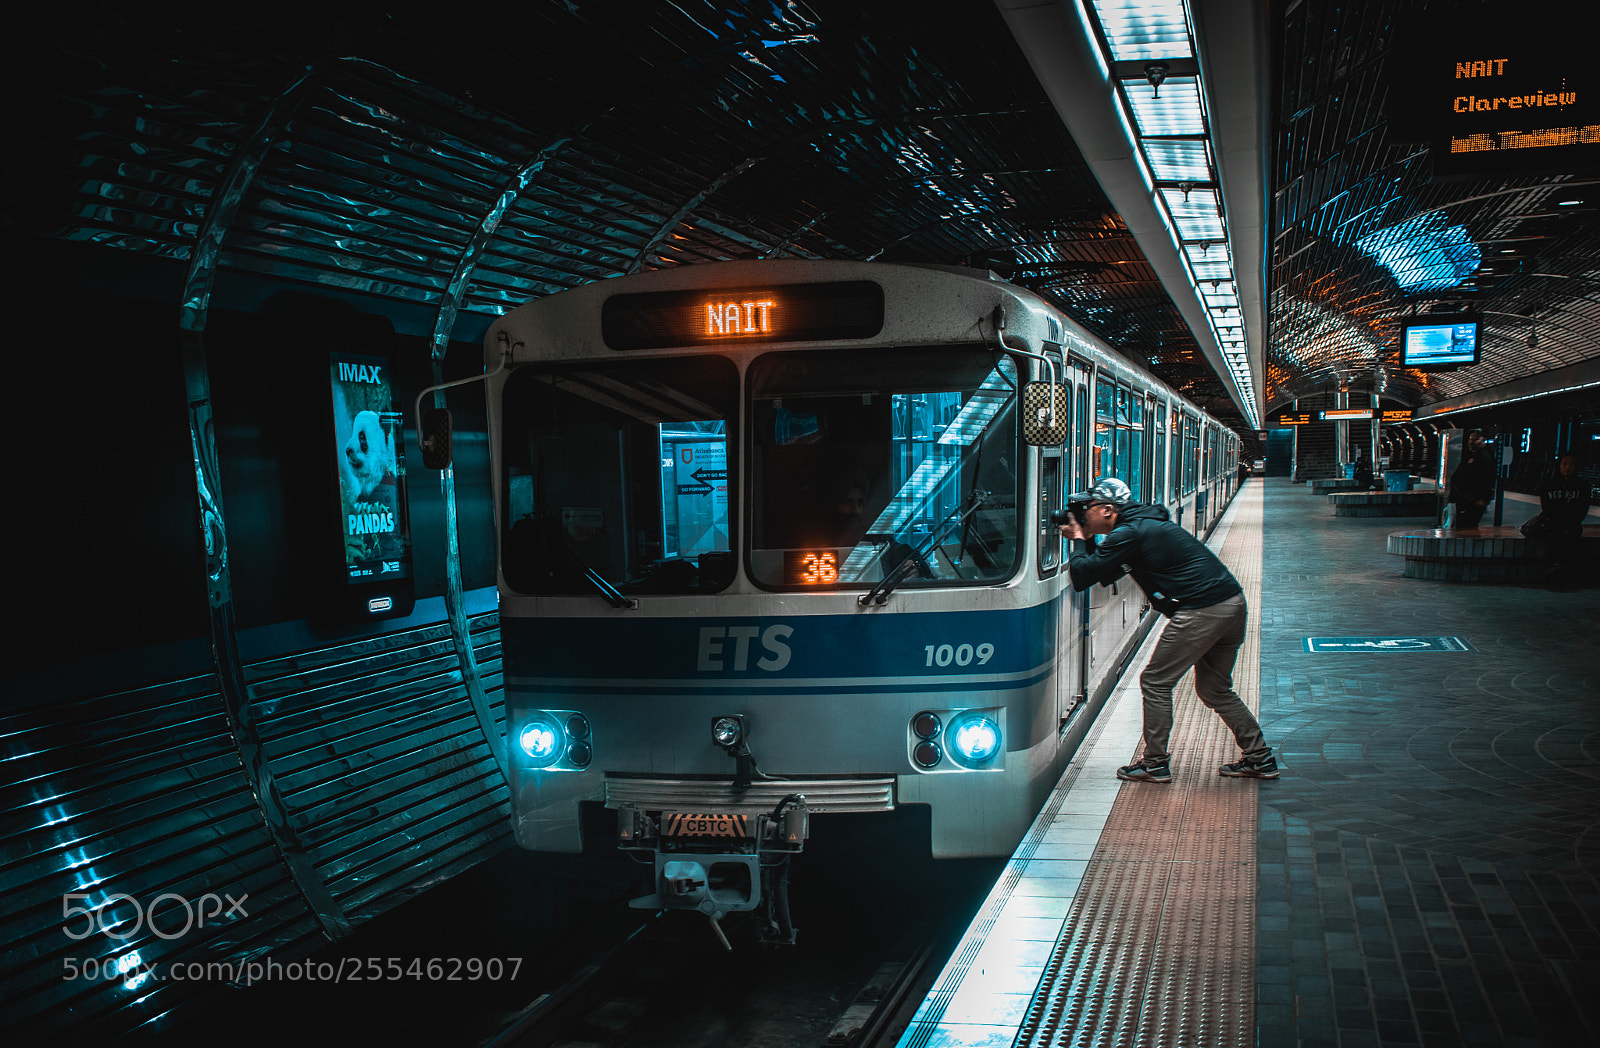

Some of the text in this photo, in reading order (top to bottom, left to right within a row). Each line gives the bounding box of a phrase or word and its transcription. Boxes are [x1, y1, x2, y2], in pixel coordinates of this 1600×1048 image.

[1455, 58, 1508, 79] NAIT
[1453, 89, 1576, 113] Clareview
[705, 300, 776, 335] NAIT
[338, 362, 382, 385] IMAX
[348, 512, 395, 536] PANDAS
[802, 553, 837, 584] 36
[697, 624, 794, 672] ETS
[924, 643, 995, 667] 1009
[686, 819, 728, 832] CBTC
